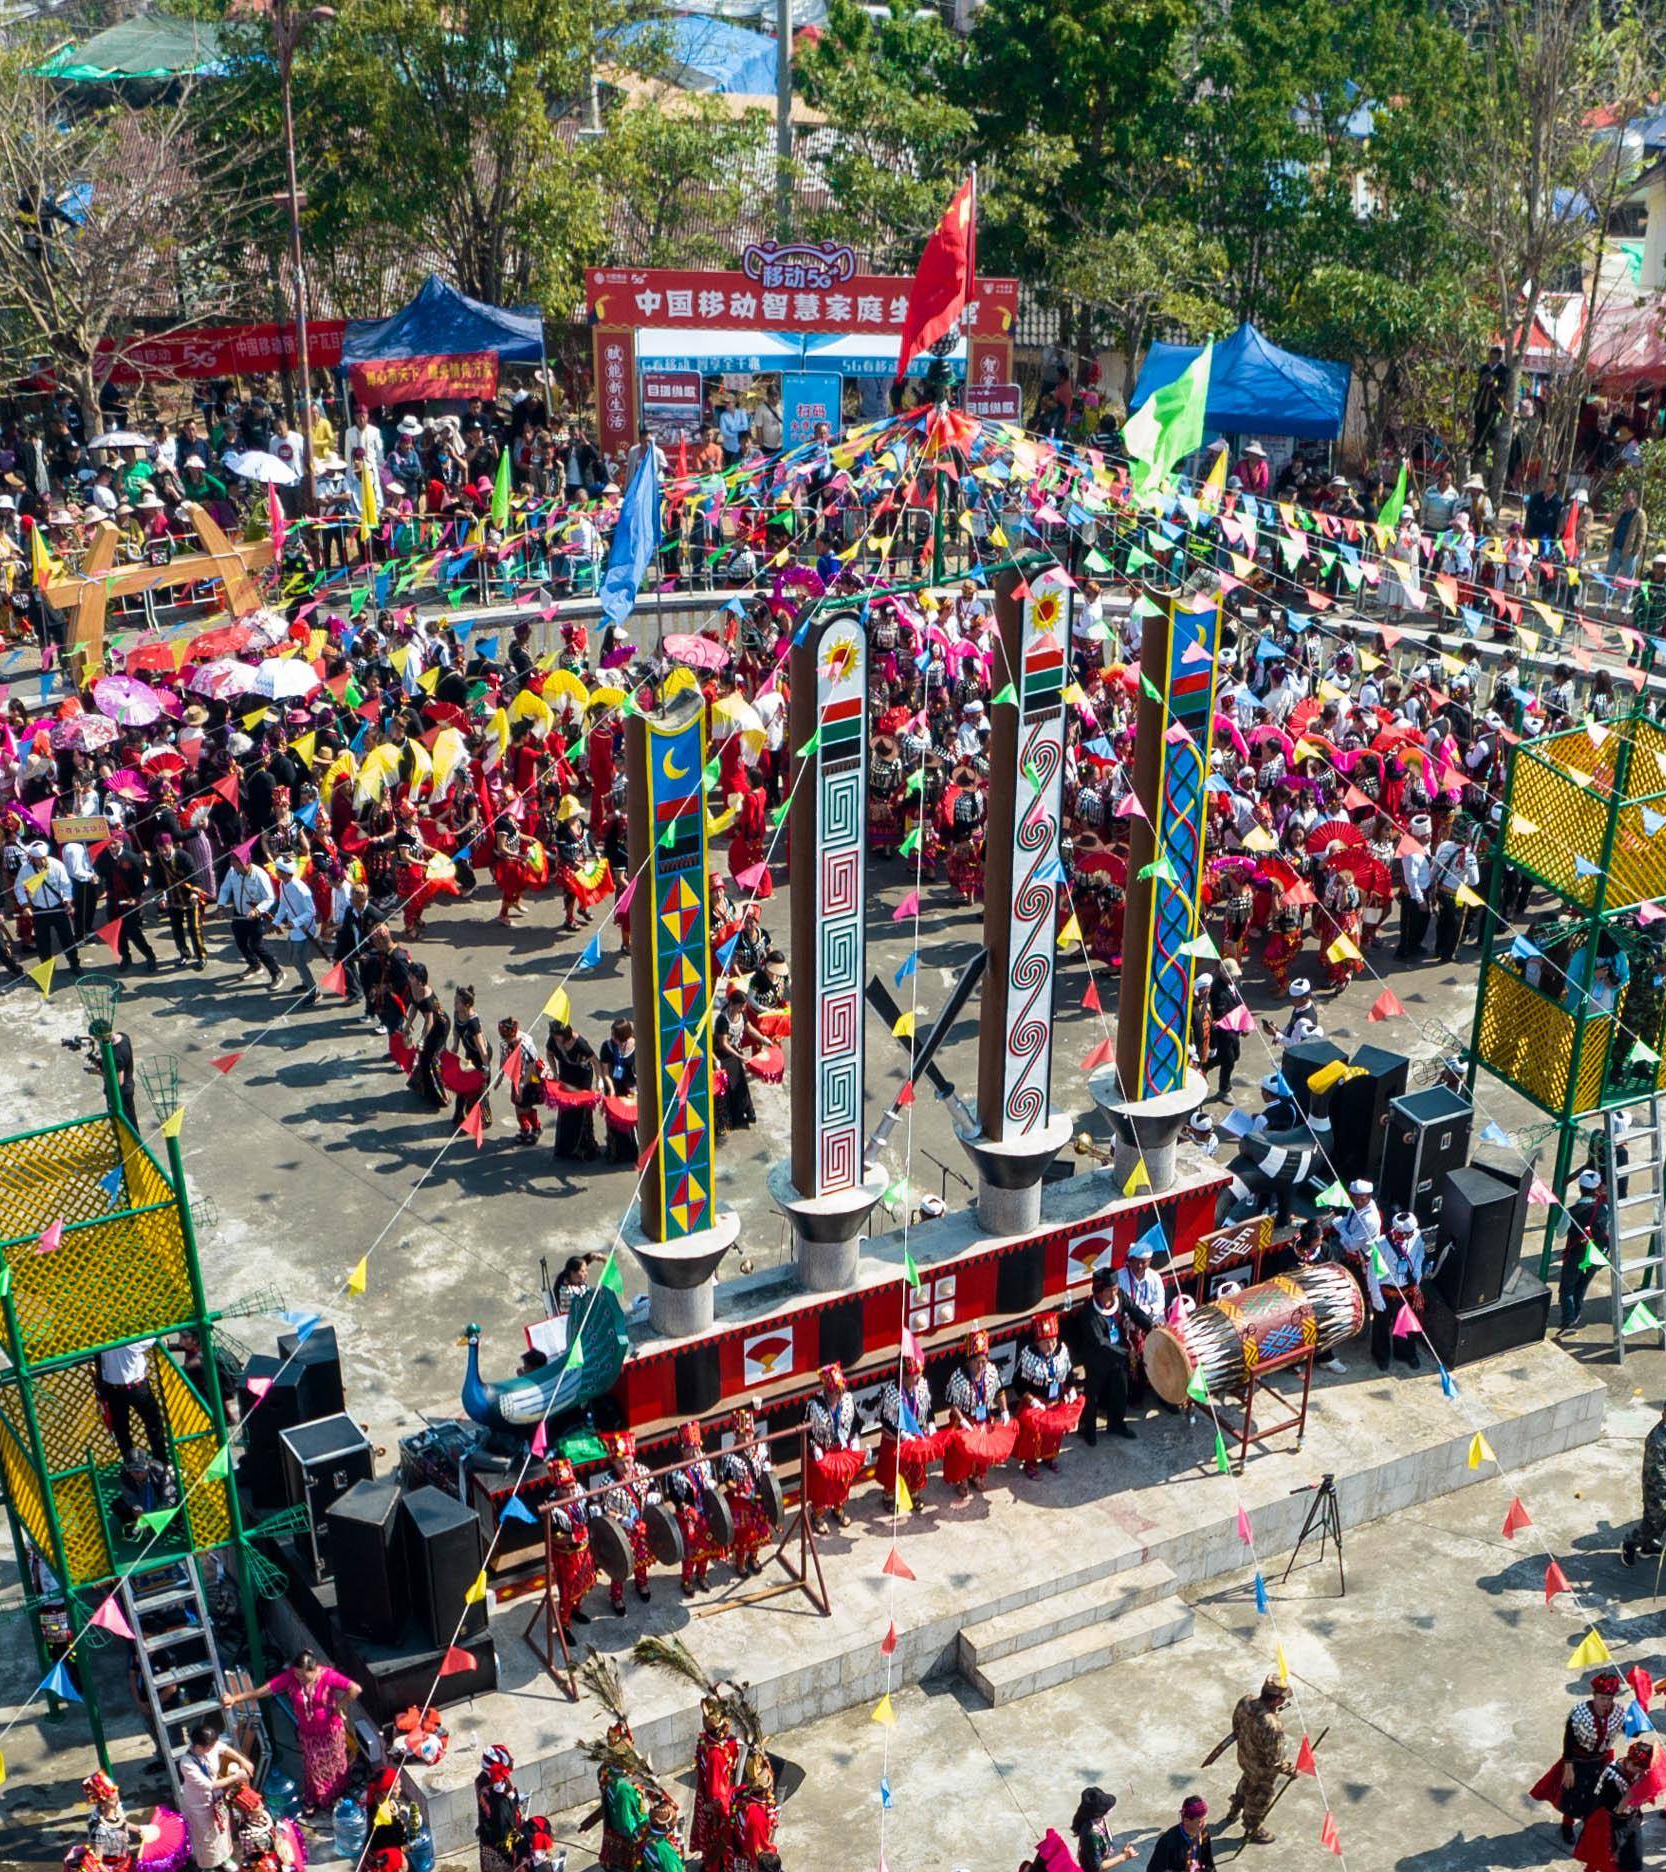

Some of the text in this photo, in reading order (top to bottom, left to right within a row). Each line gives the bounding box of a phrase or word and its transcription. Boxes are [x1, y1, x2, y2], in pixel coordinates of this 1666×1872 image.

[635, 288, 980, 326] 中国移动智慧家庭生馆
